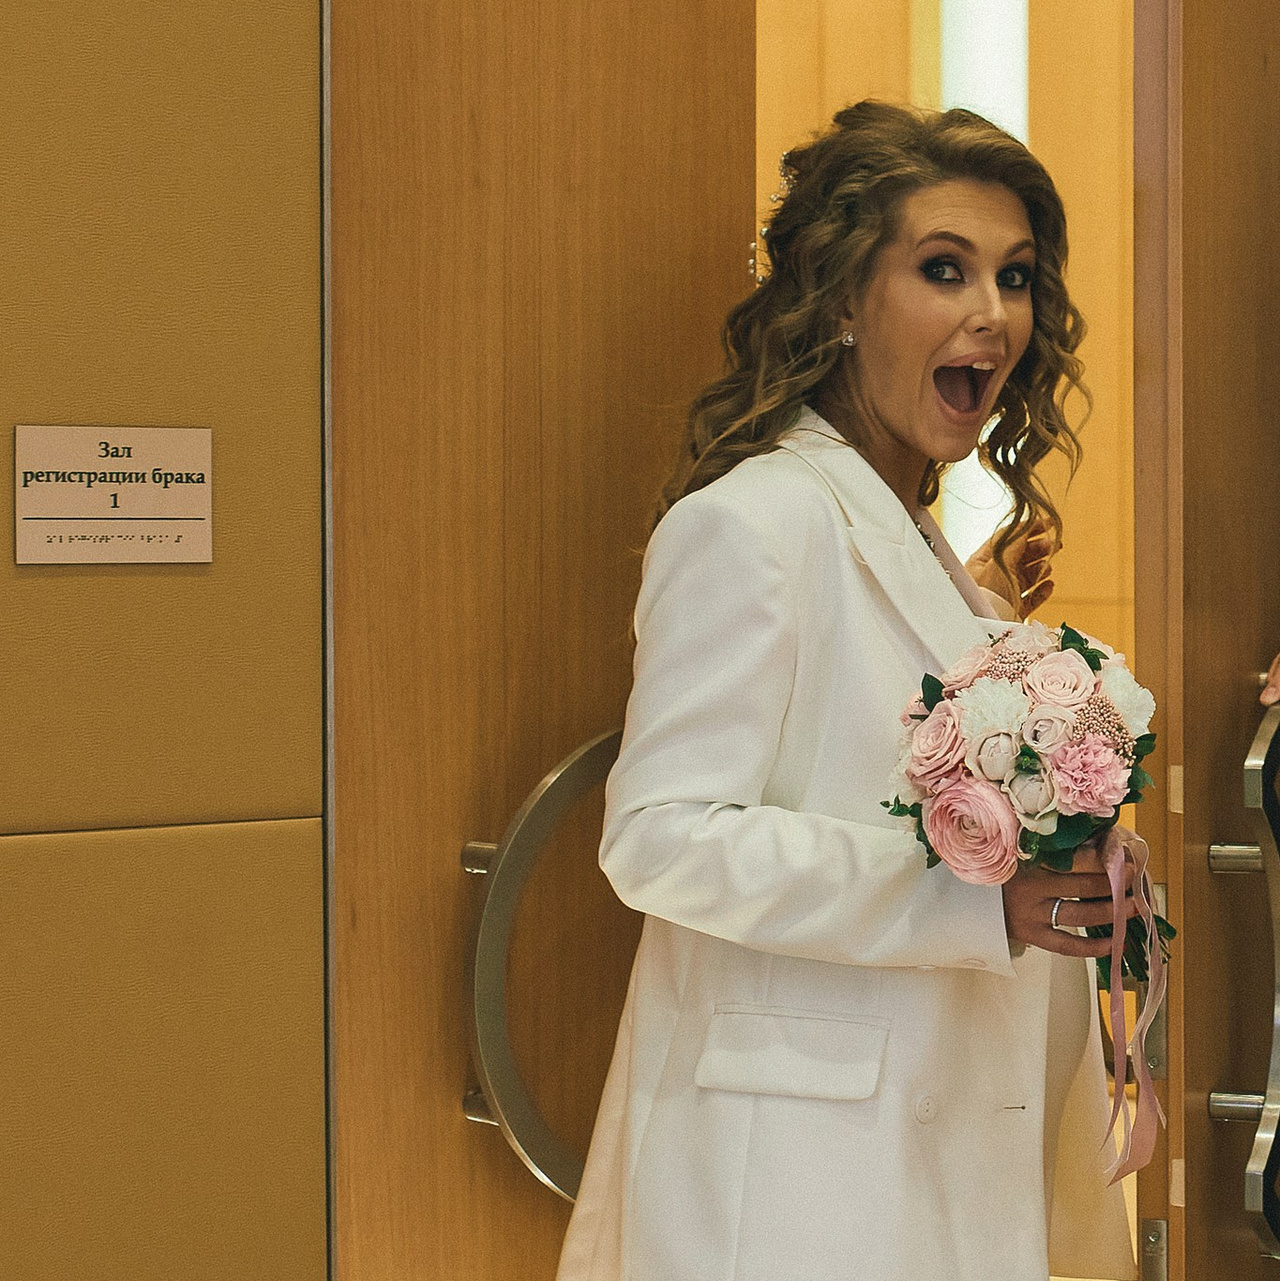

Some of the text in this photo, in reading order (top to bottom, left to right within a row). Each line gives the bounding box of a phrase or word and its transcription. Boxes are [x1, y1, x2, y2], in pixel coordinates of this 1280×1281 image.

[97, 441, 133, 458] Зал
[22, 468, 206, 489] регистрации брака
[109, 493, 120, 509] 1
